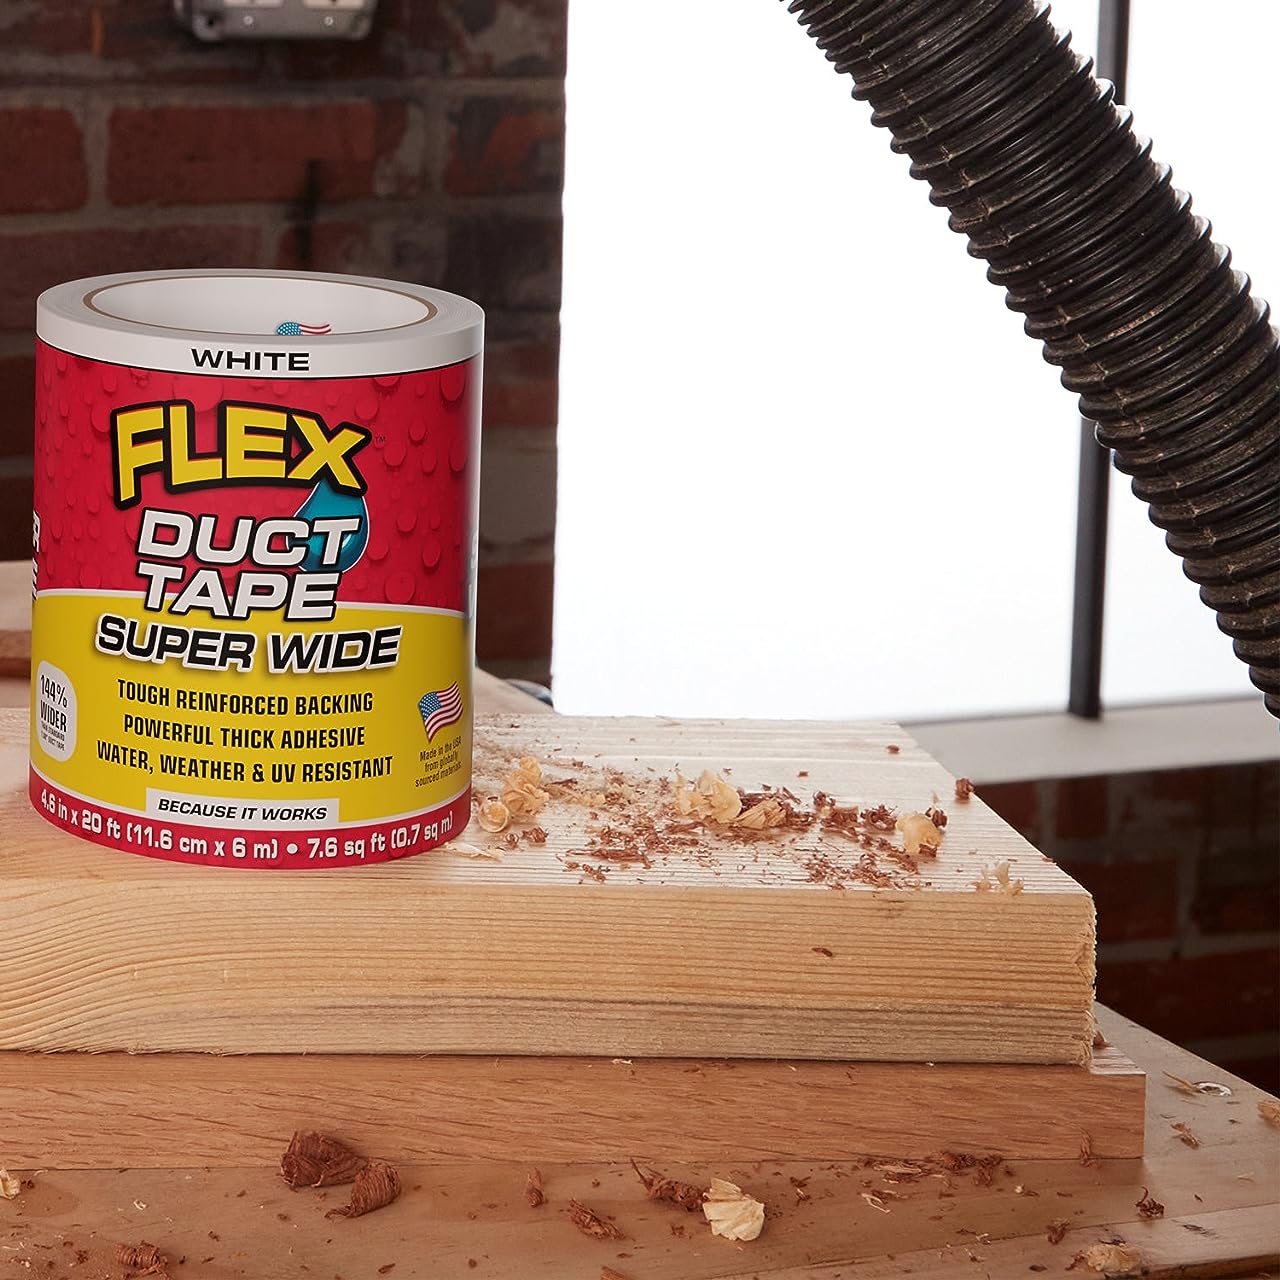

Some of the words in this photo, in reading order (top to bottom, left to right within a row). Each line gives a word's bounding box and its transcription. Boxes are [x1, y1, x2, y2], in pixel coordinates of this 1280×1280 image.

[191, 348, 310, 371] WHITE
[113, 402, 370, 507] FLEX
[136, 508, 361, 566] DUCT
[138, 567, 341, 619] TAPE
[96, 614, 257, 670] SUPER
[269, 626, 402, 672] WIDE
[40, 674, 68, 708] 144%
[118, 679, 170, 706] TOUGH
[176, 690, 288, 715] REINFORCED
[295, 692, 373, 715] BACKING
[40, 700, 67, 733] WIDER
[124, 714, 213, 746] POWERFUL
[220, 727, 275, 749] THICK
[281, 726, 365, 749] ADHESIVE
[97, 739, 153, 775] WATER,
[160, 754, 245, 781] WEATHER
[252, 763, 265, 782] &
[271, 763, 296, 782] UV
[303, 756, 393, 782] RESISTANT
[420, 749, 437, 762] Made
[41, 788, 56, 813] 4.6
[58, 798, 68, 821] in
[70, 810, 78, 825] x
[81, 809, 102, 834] 20
[106, 817, 121, 840] ft
[126, 822, 172, 850] (11.6
[179, 836, 208, 857] cm
[213, 841, 225, 857] x
[232, 837, 246, 858] 6
[253, 838, 278, 859] m)
[307, 837, 338, 859] 7.6
[344, 838, 365, 859] sq
[370, 832, 386, 853] ft
[391, 822, 420, 849] (0.7
[424, 822, 438, 842] sq
[441, 810, 453, 834] m)
[158, 798, 237, 819] BECAUSE
[241, 807, 258, 820] IT
[262, 807, 328, 821] WORKS
